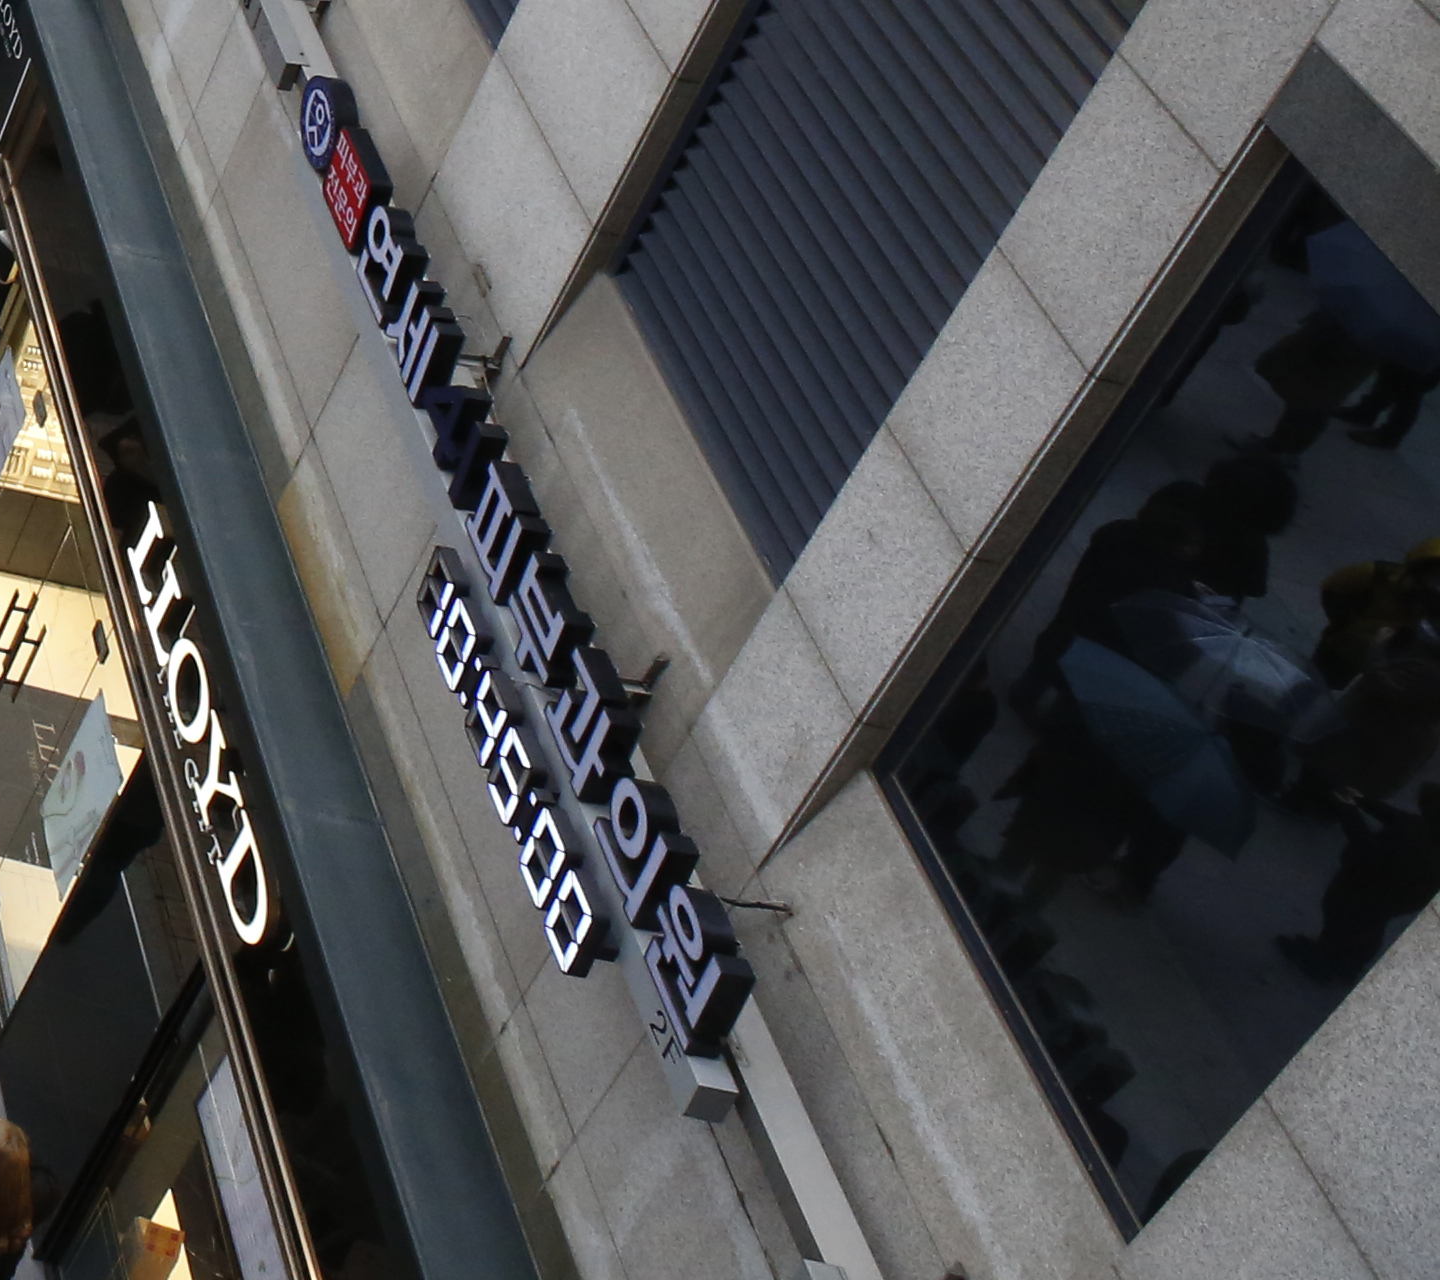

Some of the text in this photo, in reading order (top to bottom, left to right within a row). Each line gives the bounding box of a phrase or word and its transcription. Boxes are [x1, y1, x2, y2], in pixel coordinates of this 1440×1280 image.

[326, 165, 358, 243] 전문의
[336, 134, 367, 209] 피부과
[356, 203, 442, 404] 연세
[127, 500, 269, 945] LLOYD
[465, 461, 722, 1055] 피부과 의원
[648, 1008, 681, 1065] 2F
